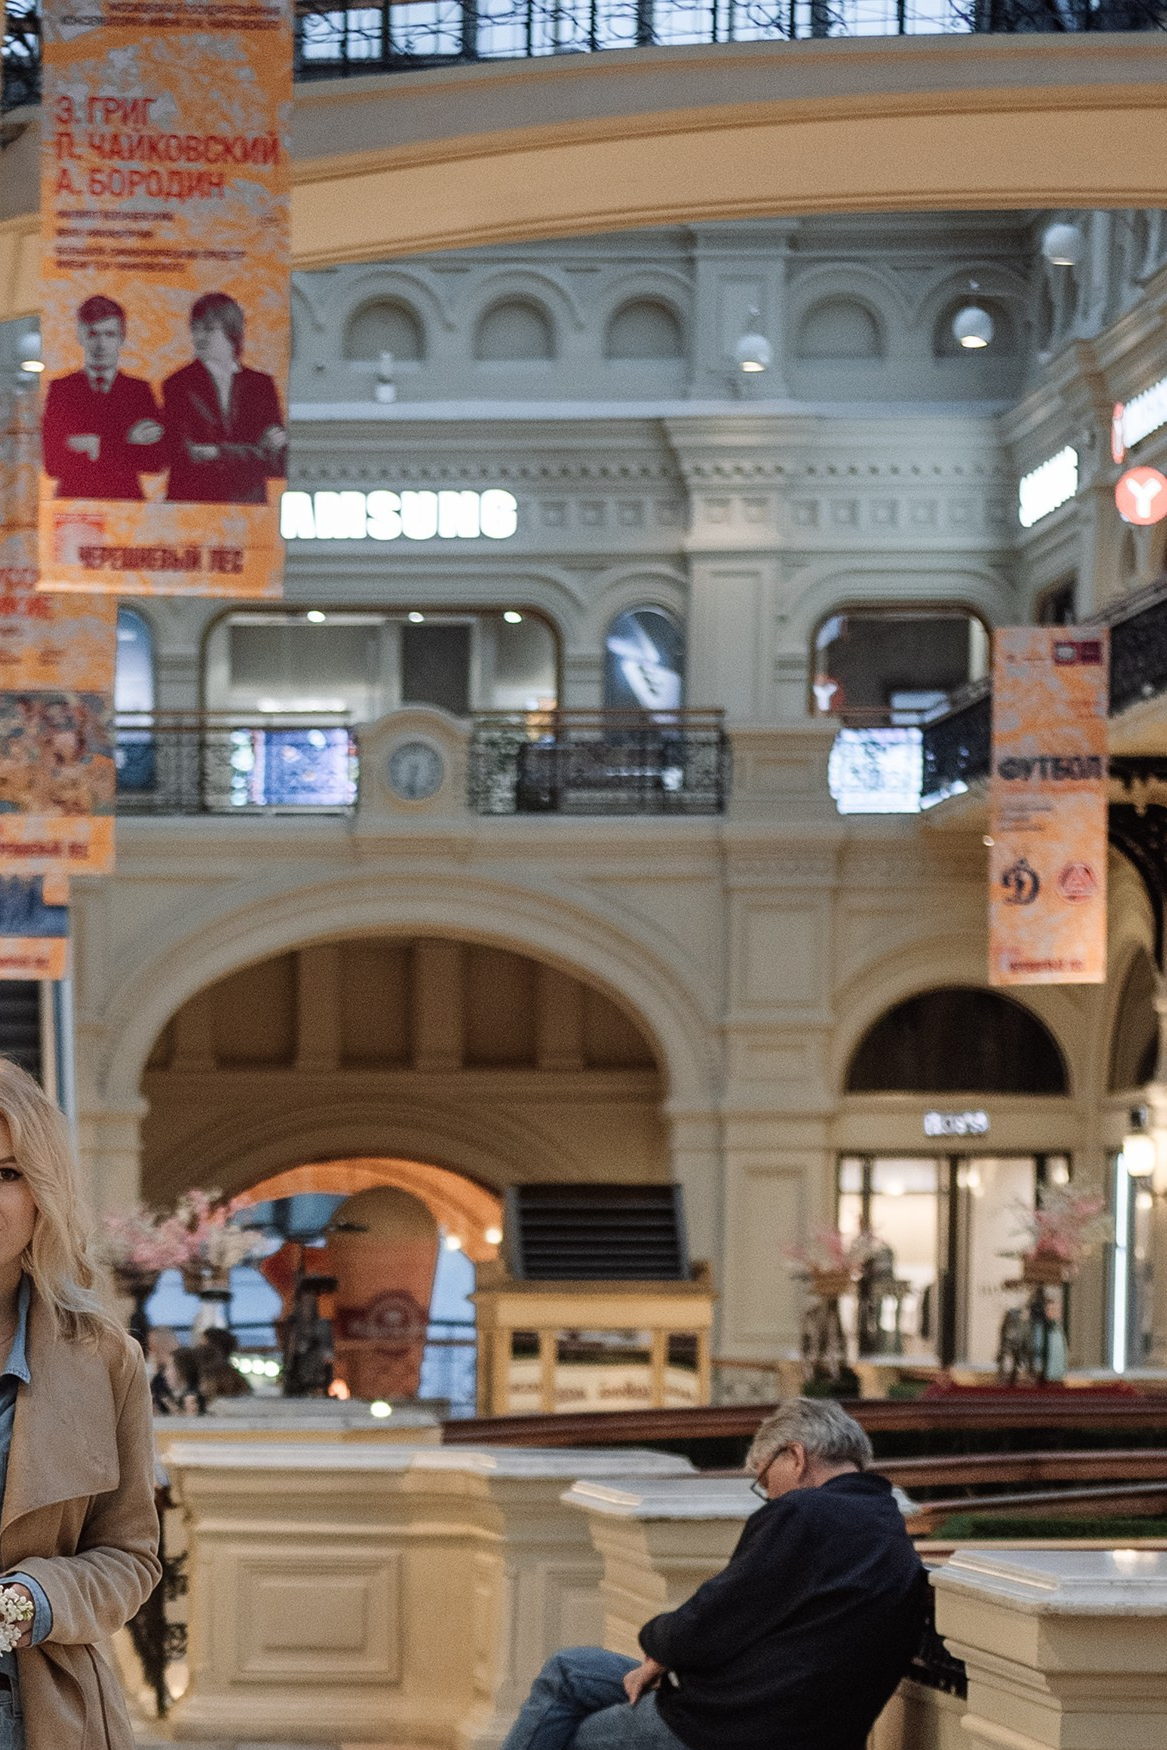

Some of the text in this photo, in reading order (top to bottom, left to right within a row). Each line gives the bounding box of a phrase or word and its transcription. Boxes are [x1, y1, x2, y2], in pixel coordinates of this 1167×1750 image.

[88, 97, 157, 126] ГРИГ
[55, 131, 281, 165] П. ЧАЙКОВСКИЙ
[54, 168, 225, 204] А. БОРОДИН
[280, 489, 518, 540] AMSUNG
[997, 755, 1103, 781] ФУТБОЛ
